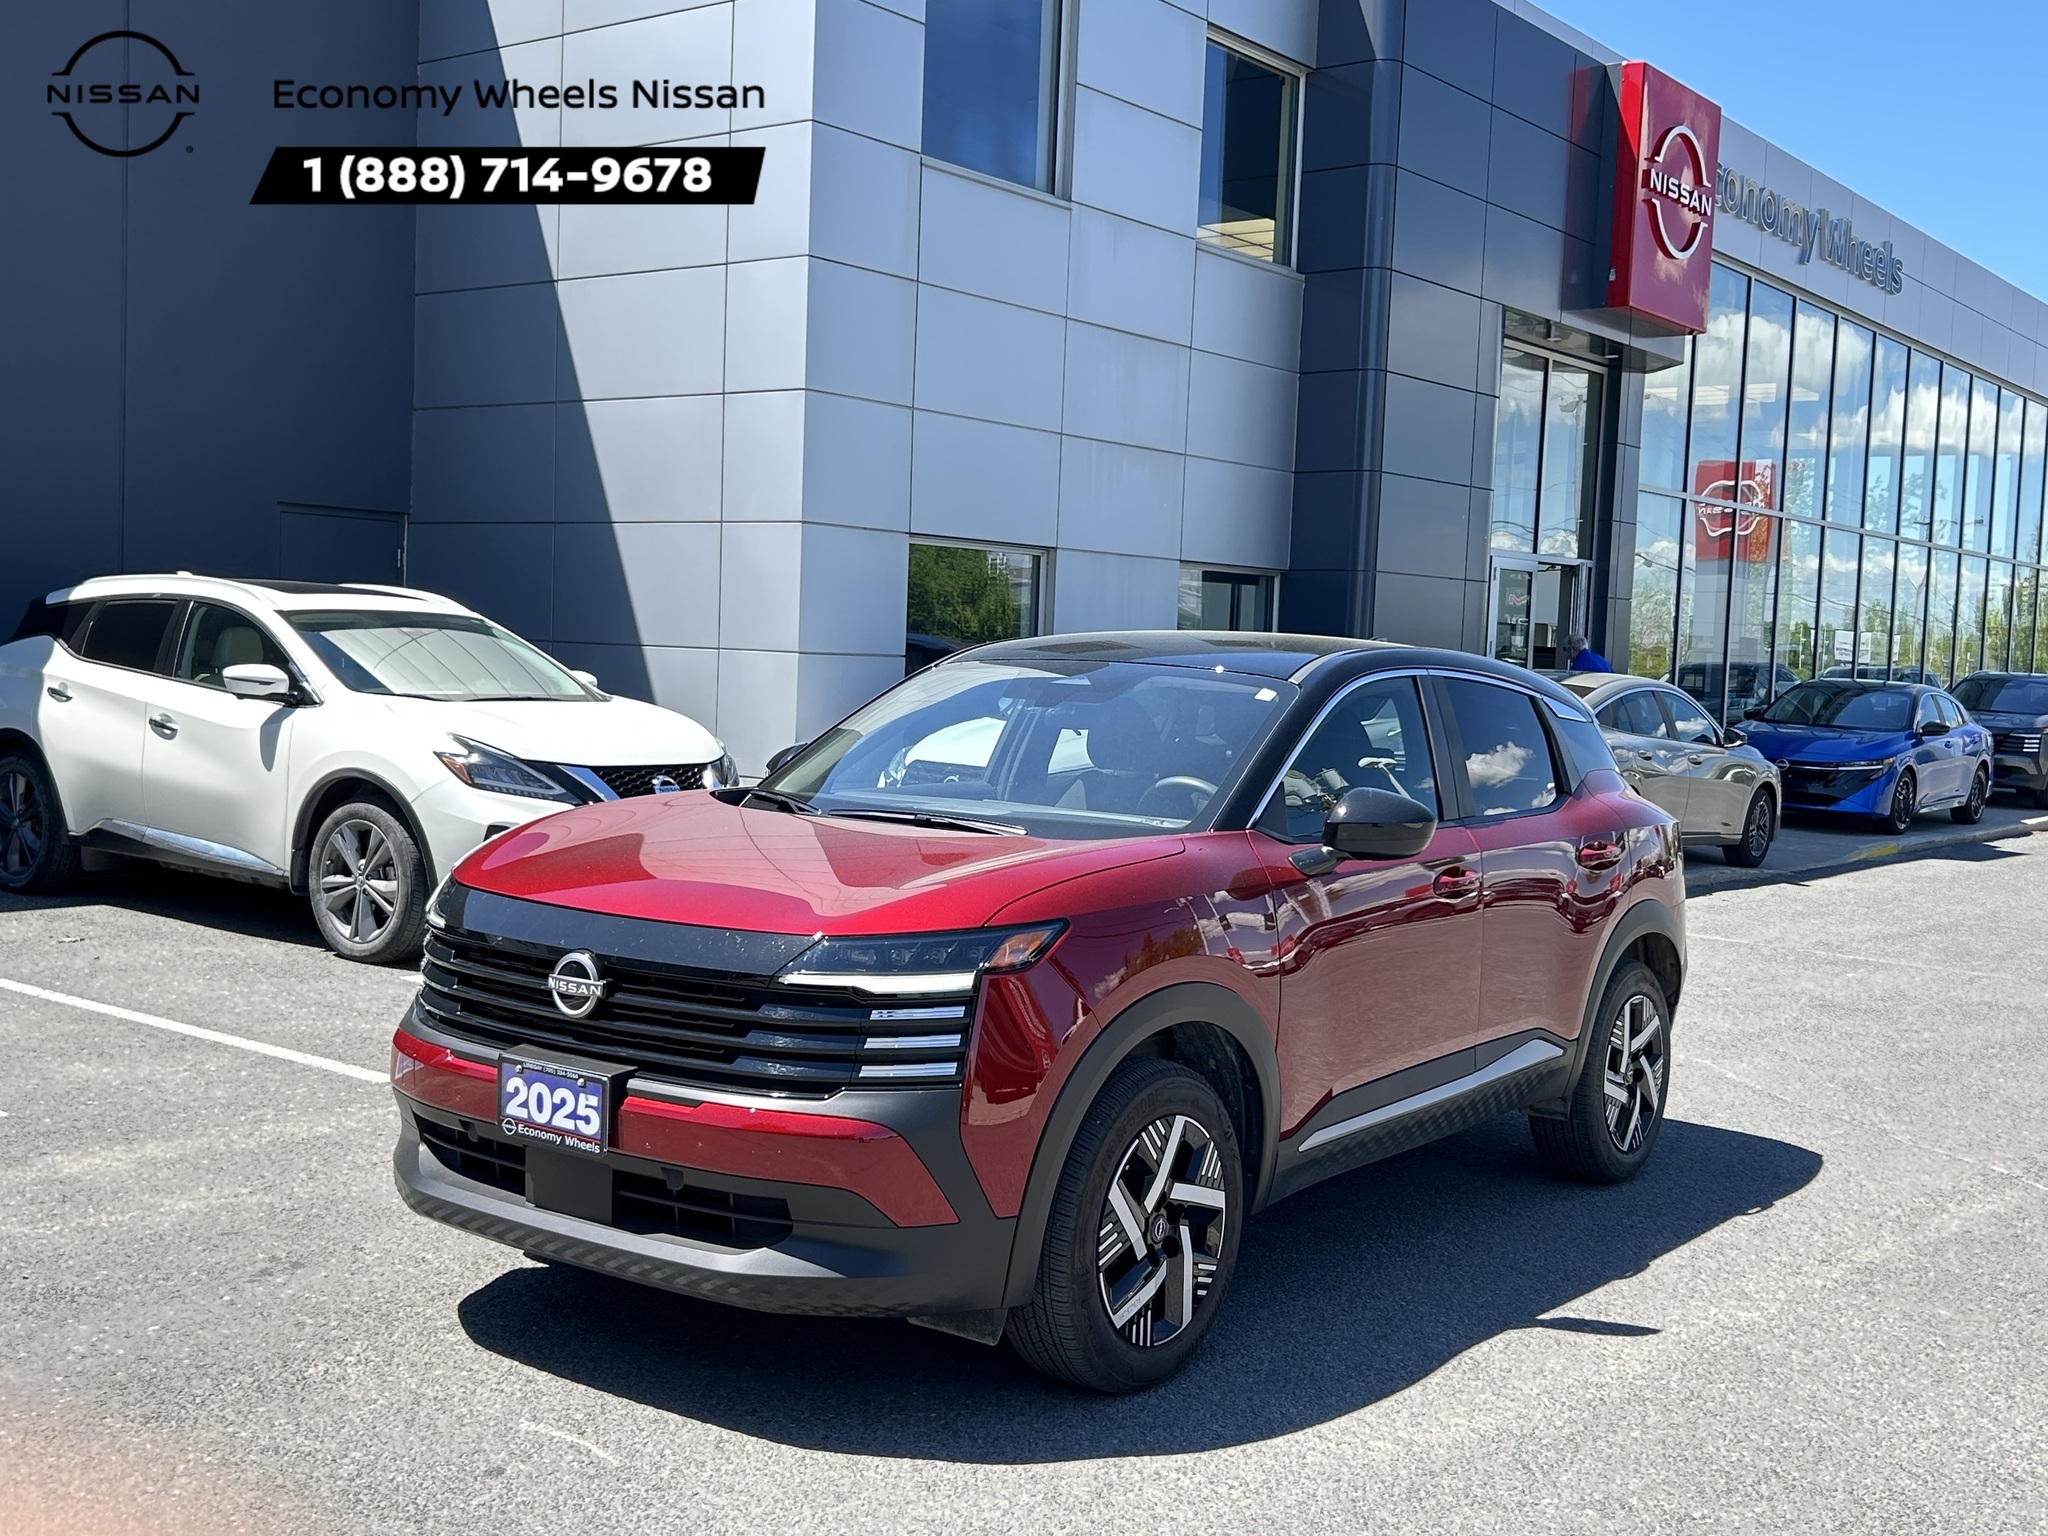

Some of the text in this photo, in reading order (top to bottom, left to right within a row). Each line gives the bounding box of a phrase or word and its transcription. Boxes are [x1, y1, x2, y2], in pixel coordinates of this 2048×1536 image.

[1649, 168, 1712, 216] NISSAN
[1715, 161, 1905, 296] conomy Wheels
[548, 977, 601, 996] NISSAN
[506, 1077, 600, 1135] 2025
[518, 1124, 600, 1153] Economy Wheels
